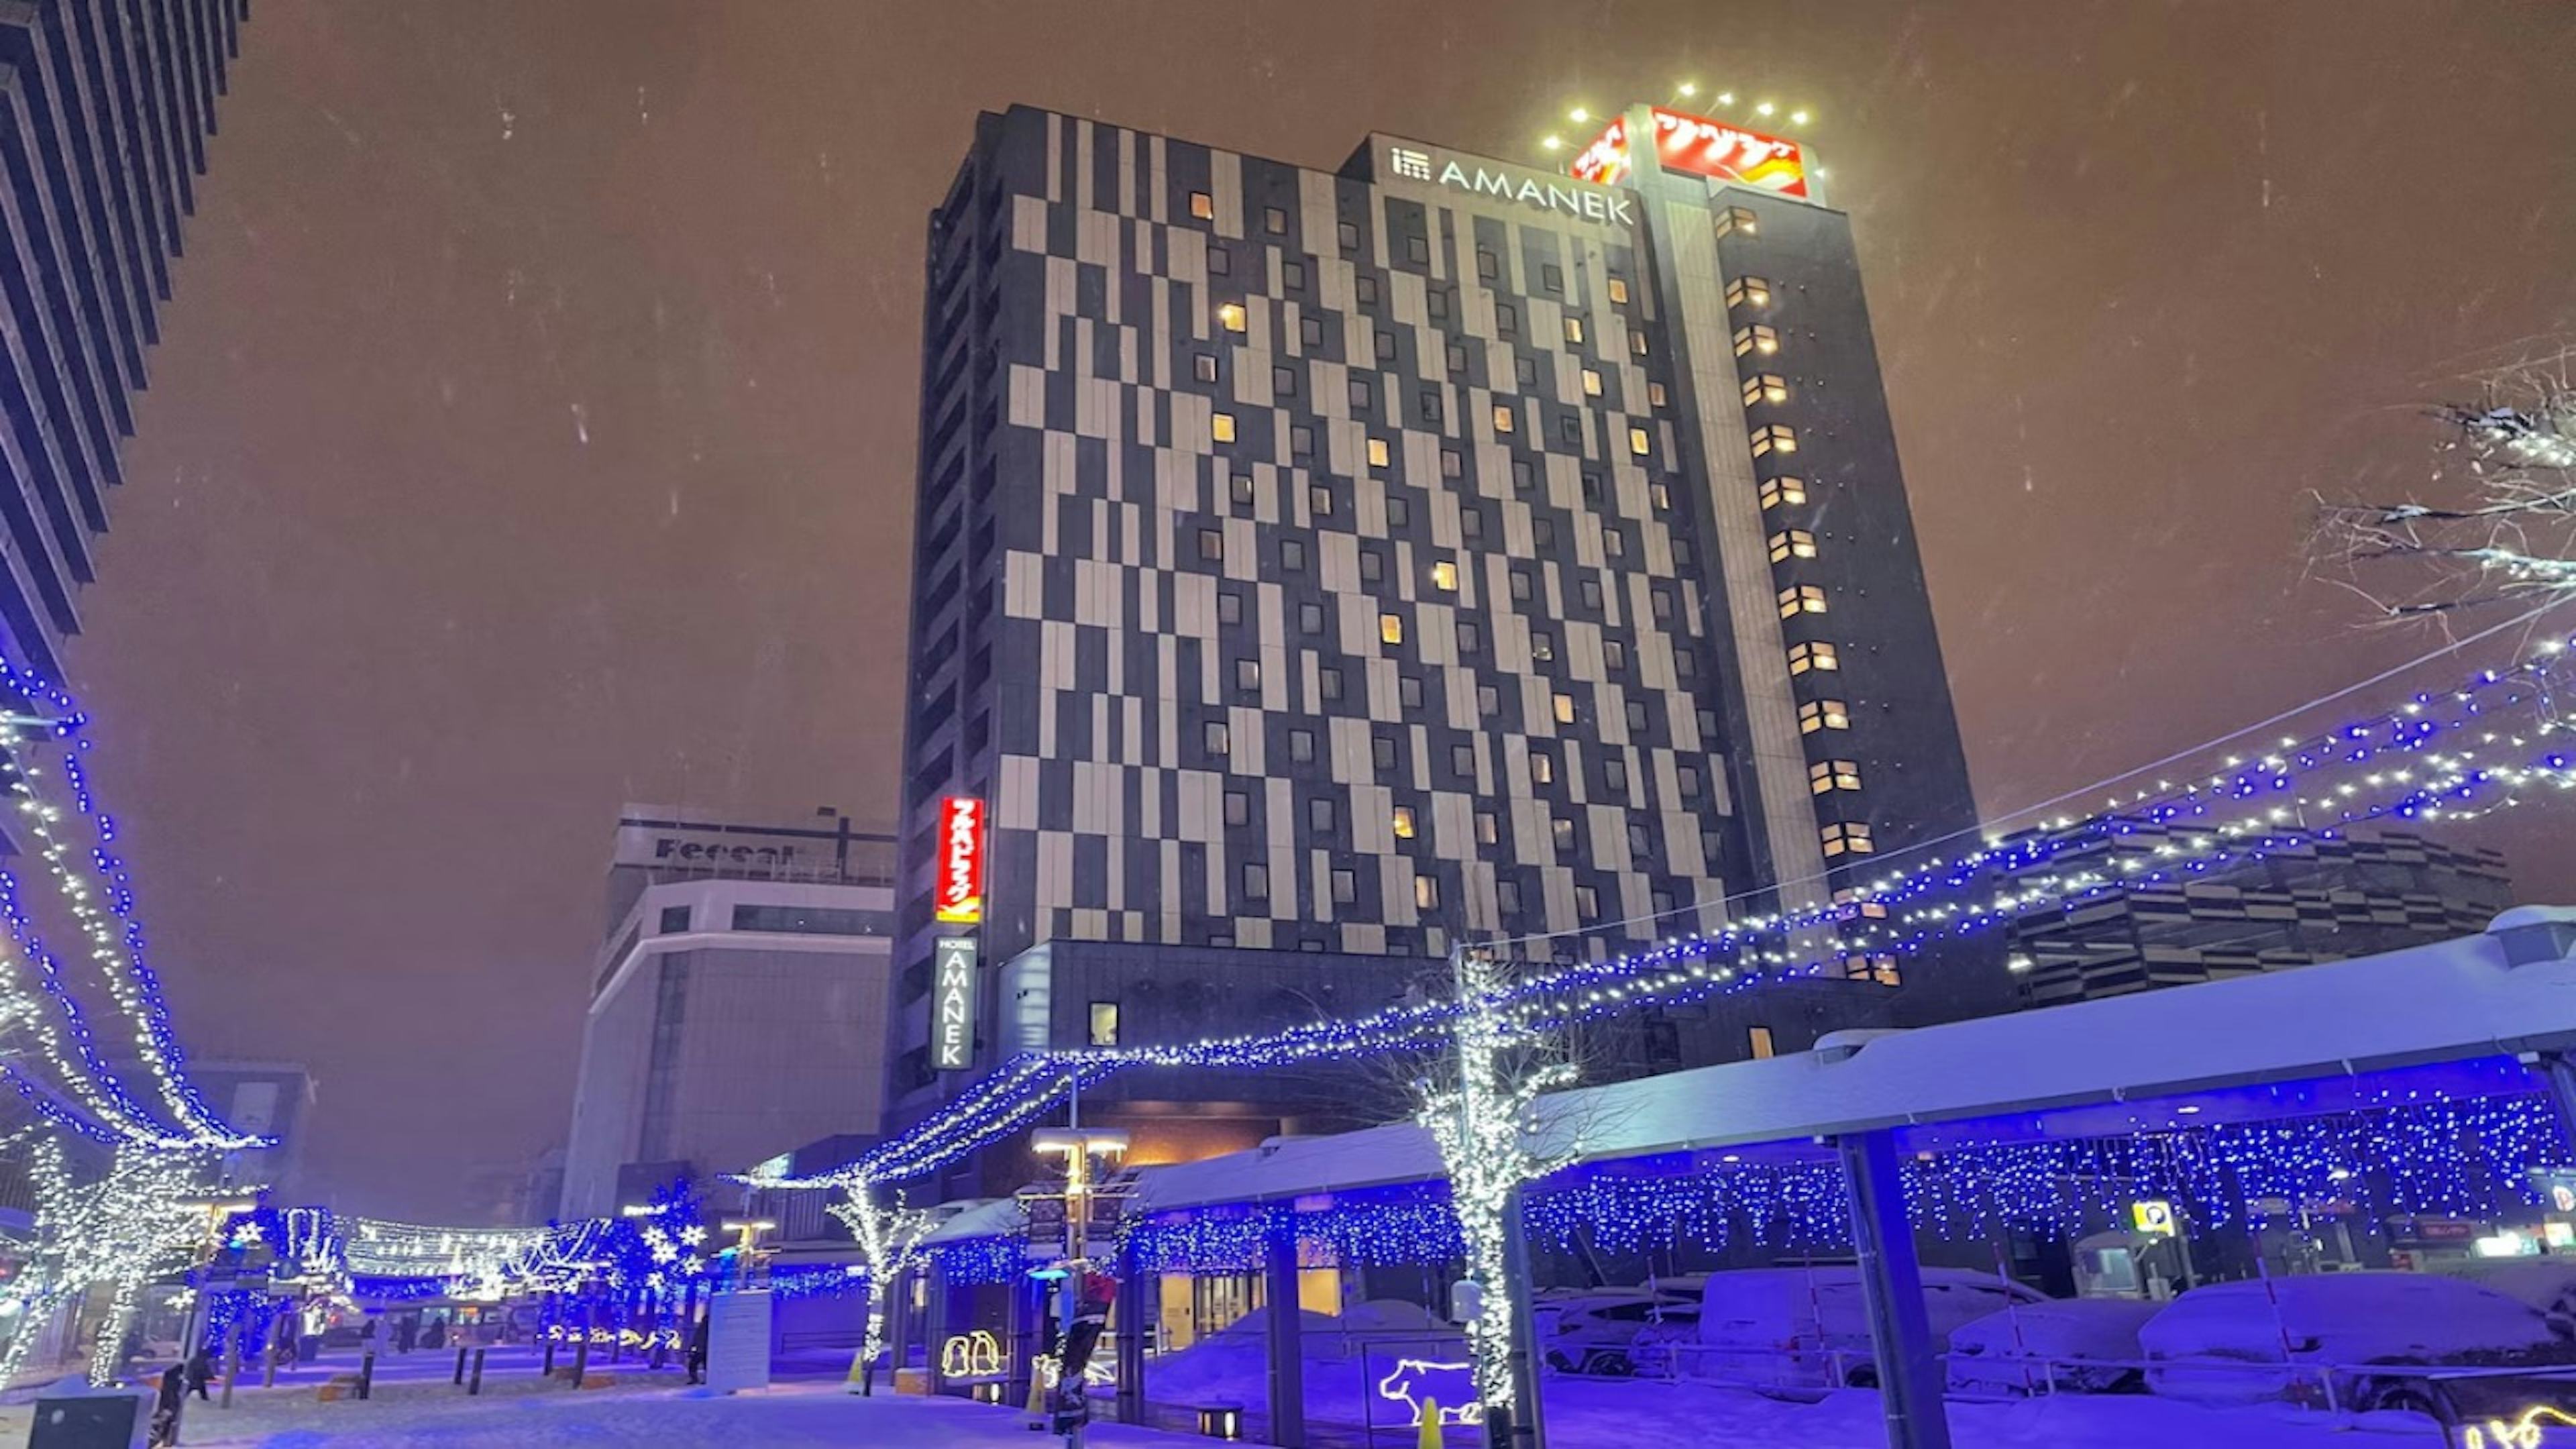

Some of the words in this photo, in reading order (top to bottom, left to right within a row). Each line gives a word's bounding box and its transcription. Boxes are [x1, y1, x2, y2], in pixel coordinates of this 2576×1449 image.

[1438, 160, 1633, 225] AMANEK
[939, 940, 975, 951] HOTEL
[941, 951, 967, 1065] AMANEK
